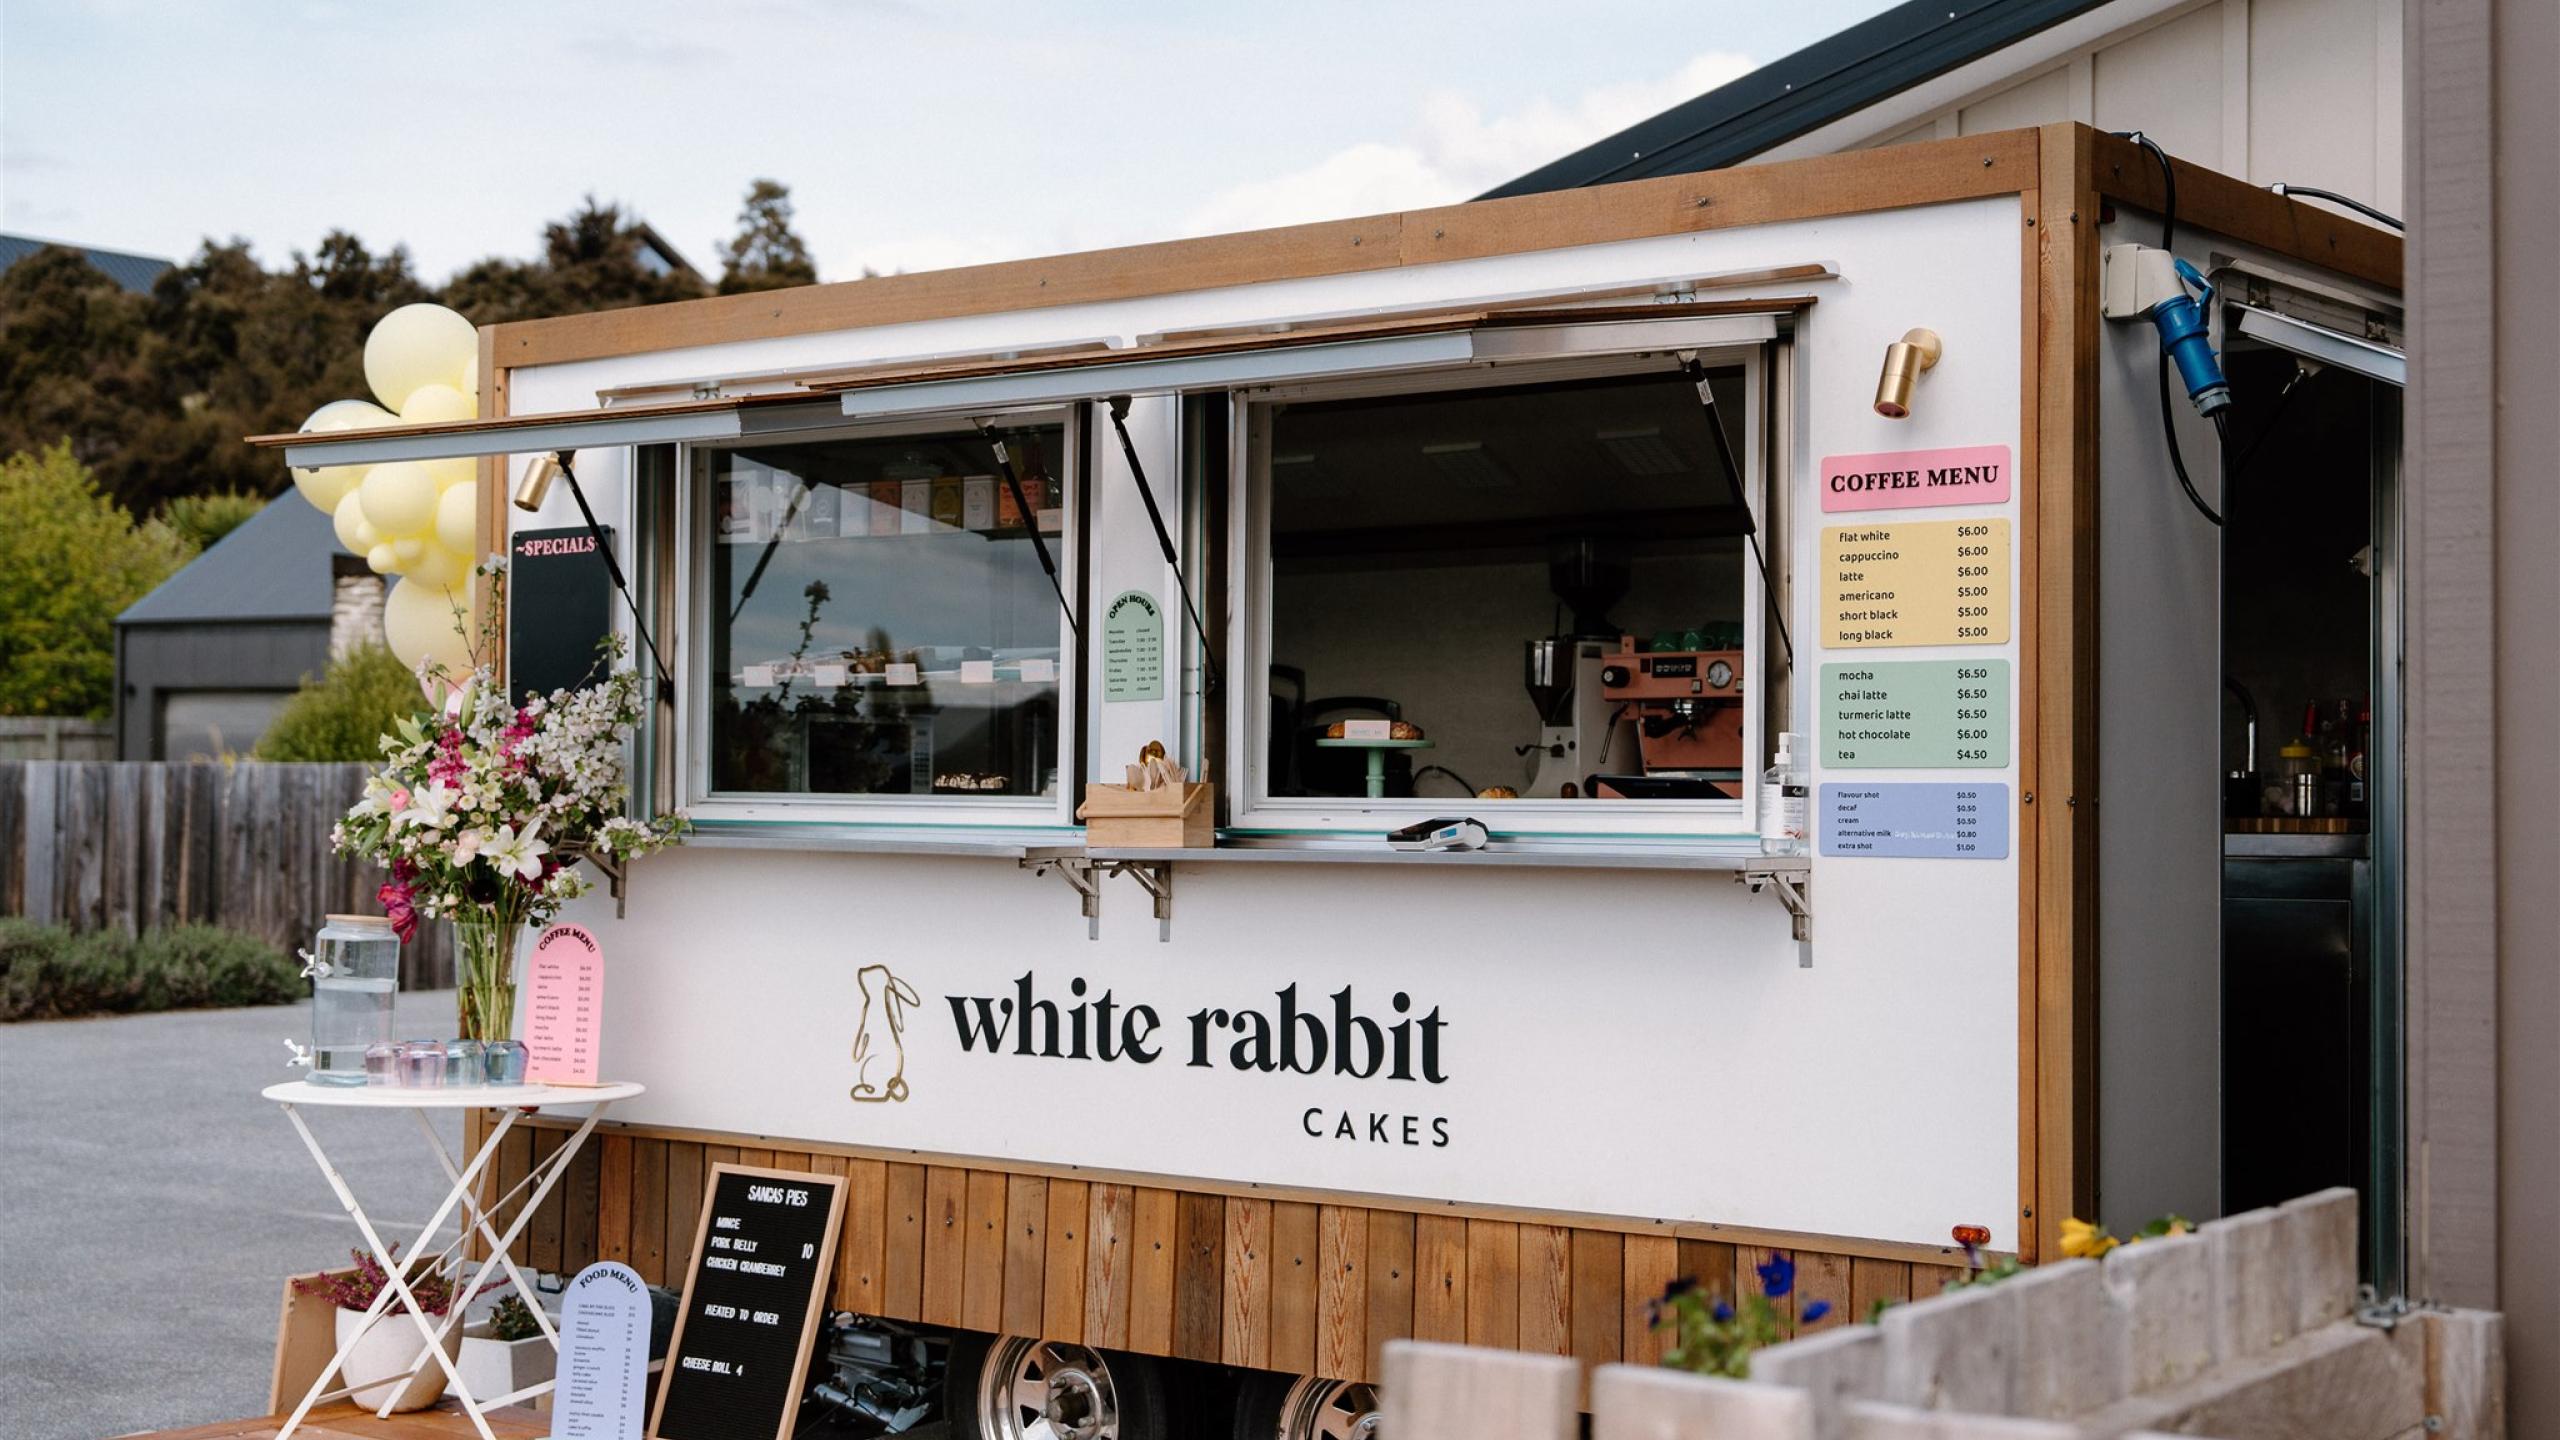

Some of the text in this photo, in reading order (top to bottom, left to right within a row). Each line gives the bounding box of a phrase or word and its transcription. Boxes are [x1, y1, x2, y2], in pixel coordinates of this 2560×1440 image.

[1831, 465, 1998, 492] COFFEE MENU
[1840, 526, 1988, 542] flat white $6.00
[1840, 546, 1988, 563] cappuccino $6.00
[1840, 567, 1988, 581] latte $6.00
[1840, 587, 1988, 601] americano $5.00
[1109, 595, 1155, 619] OPEN HOURS
[1840, 607, 1988, 621] short black $5.00
[1840, 627, 1988, 642] long black $5.00
[1839, 668, 1987, 680] mocha $6.50
[1839, 689, 1986, 701] chai latte $6.50
[1839, 709, 1986, 720] turmeric latte $6.50
[1839, 729, 1987, 740] hot chocolate $6.00
[1839, 749, 1987, 760] tea $4.50
[539, 928, 595, 953] COFFEE MENU
[945, 971, 1448, 1084] white rabbit
[1303, 1108, 1449, 1147] CAKES
[786, 1189, 808, 1206] PIES
[716, 1217, 741, 1229] MINCE
[711, 1236, 813, 1259] PORK BELLY 10
[706, 1256, 738, 1270] CHICKEN
[580, 1268, 638, 1293] FOOD MENU
[705, 1304, 779, 1325] HEATED TO ORDER
[683, 1356, 743, 1376] CHEESE ROLL 4
